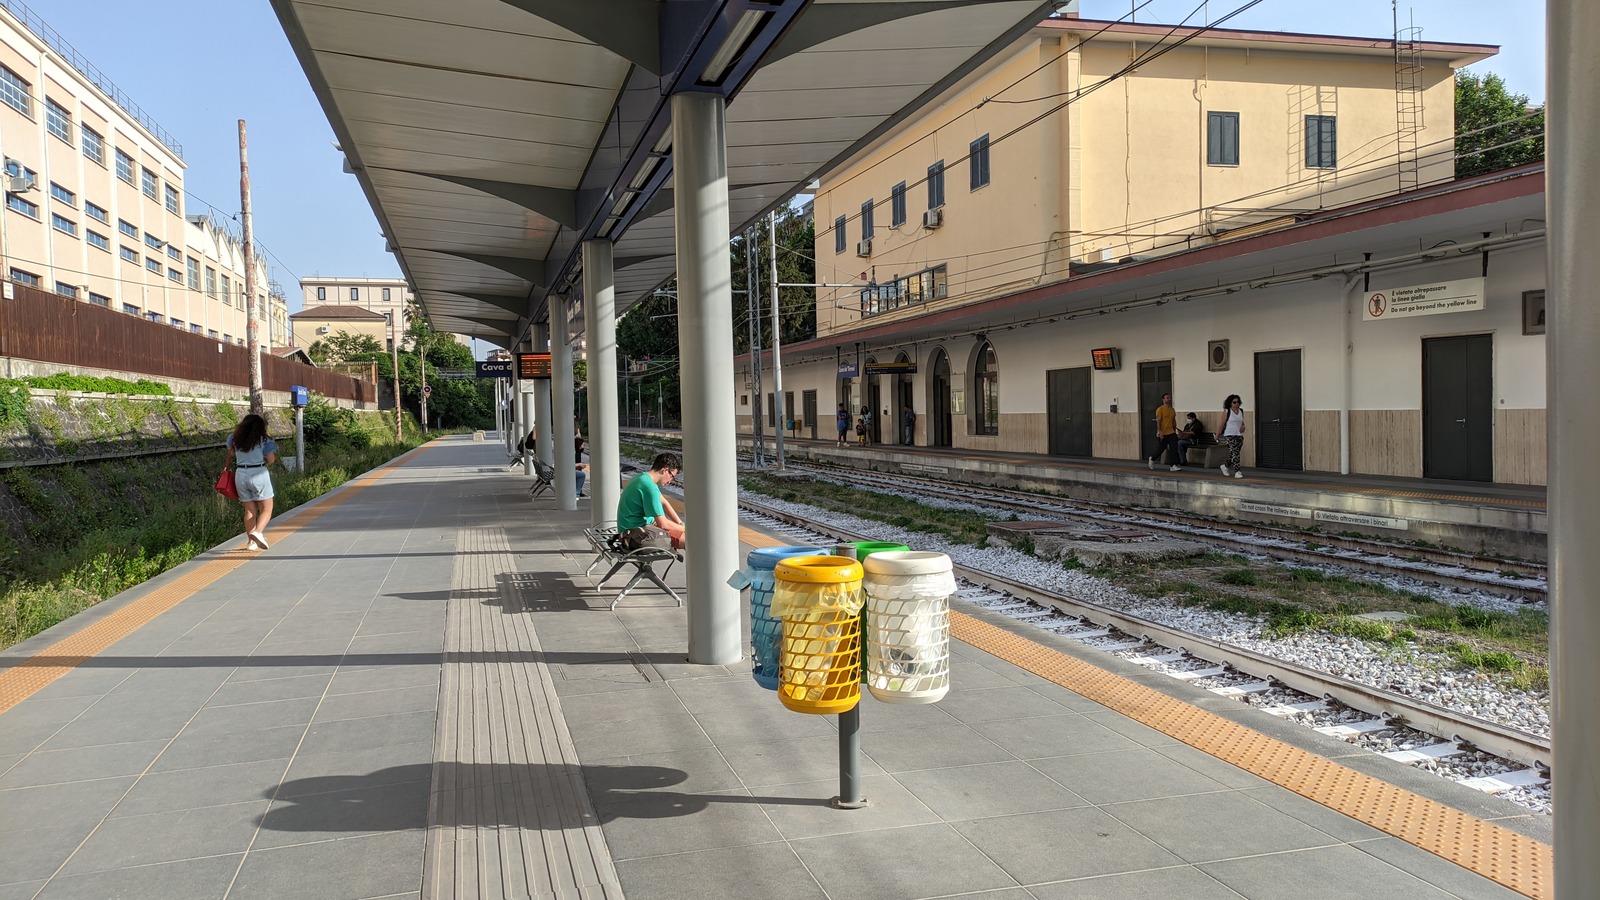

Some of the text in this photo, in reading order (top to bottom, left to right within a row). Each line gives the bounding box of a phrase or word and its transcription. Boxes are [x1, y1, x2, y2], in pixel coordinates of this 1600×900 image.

[1416, 302, 1436, 311] beyond
[1446, 300, 1466, 308] yellow
[1274, 506, 1288, 515] railway
[1340, 515, 1370, 524] attraversare
